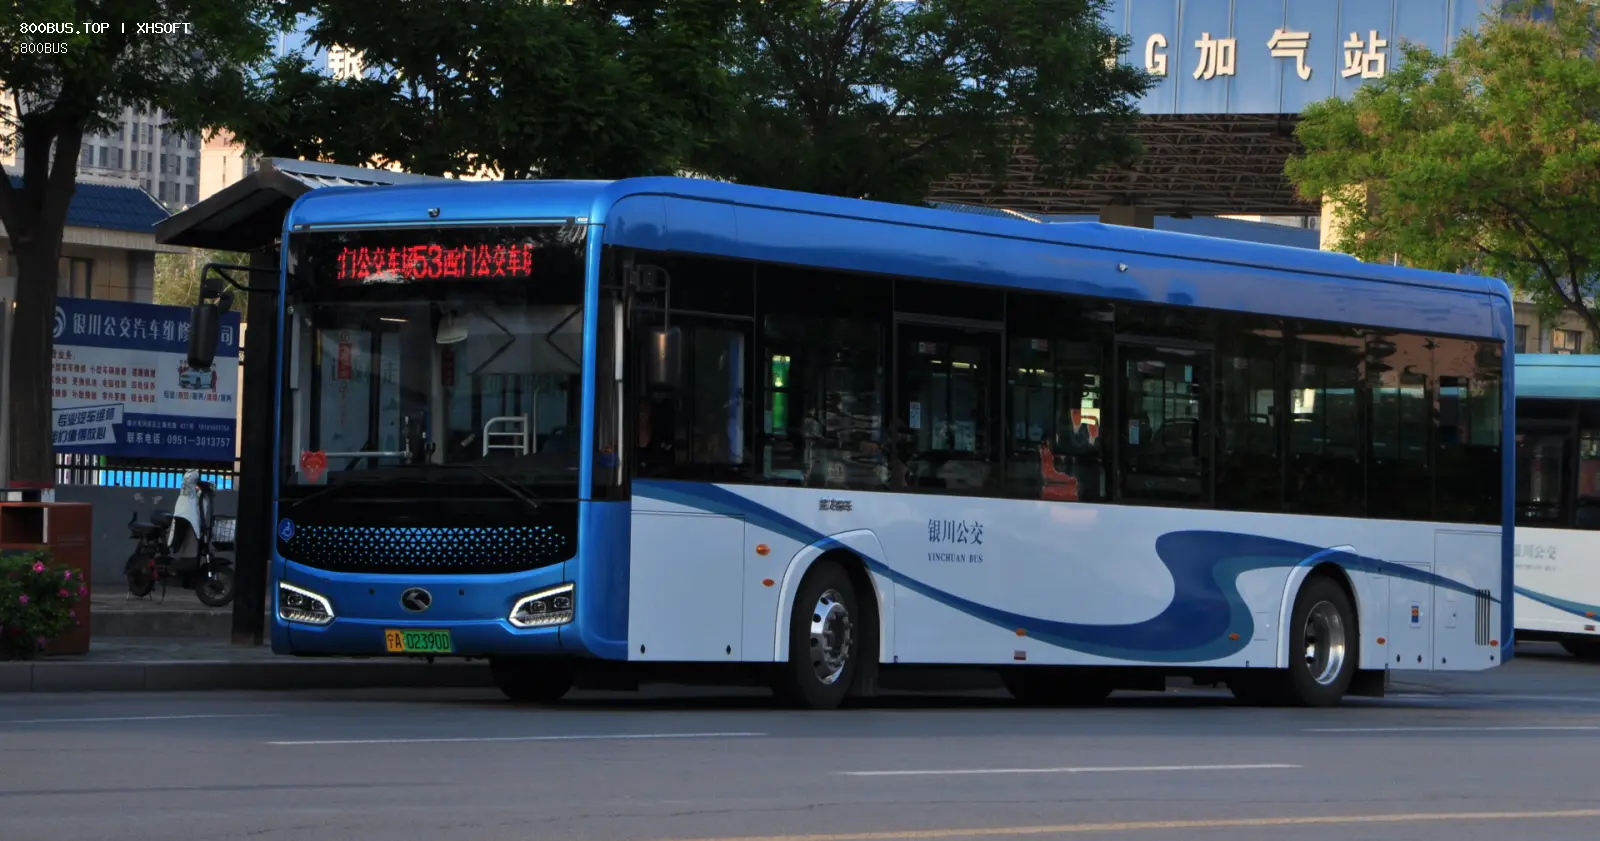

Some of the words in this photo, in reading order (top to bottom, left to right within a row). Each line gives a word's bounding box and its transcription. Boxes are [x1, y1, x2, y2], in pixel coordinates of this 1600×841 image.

[1098, 29, 1388, 81] G加气站
[337, 247, 413, 280] 门公交车场
[413, 245, 443, 280] 53
[73, 312, 233, 346] 银川公交汽车维修司
[928, 518, 983, 546] 银川公交
[928, 552, 966, 562] YINCHUAN
[969, 553, 983, 563] BUS
